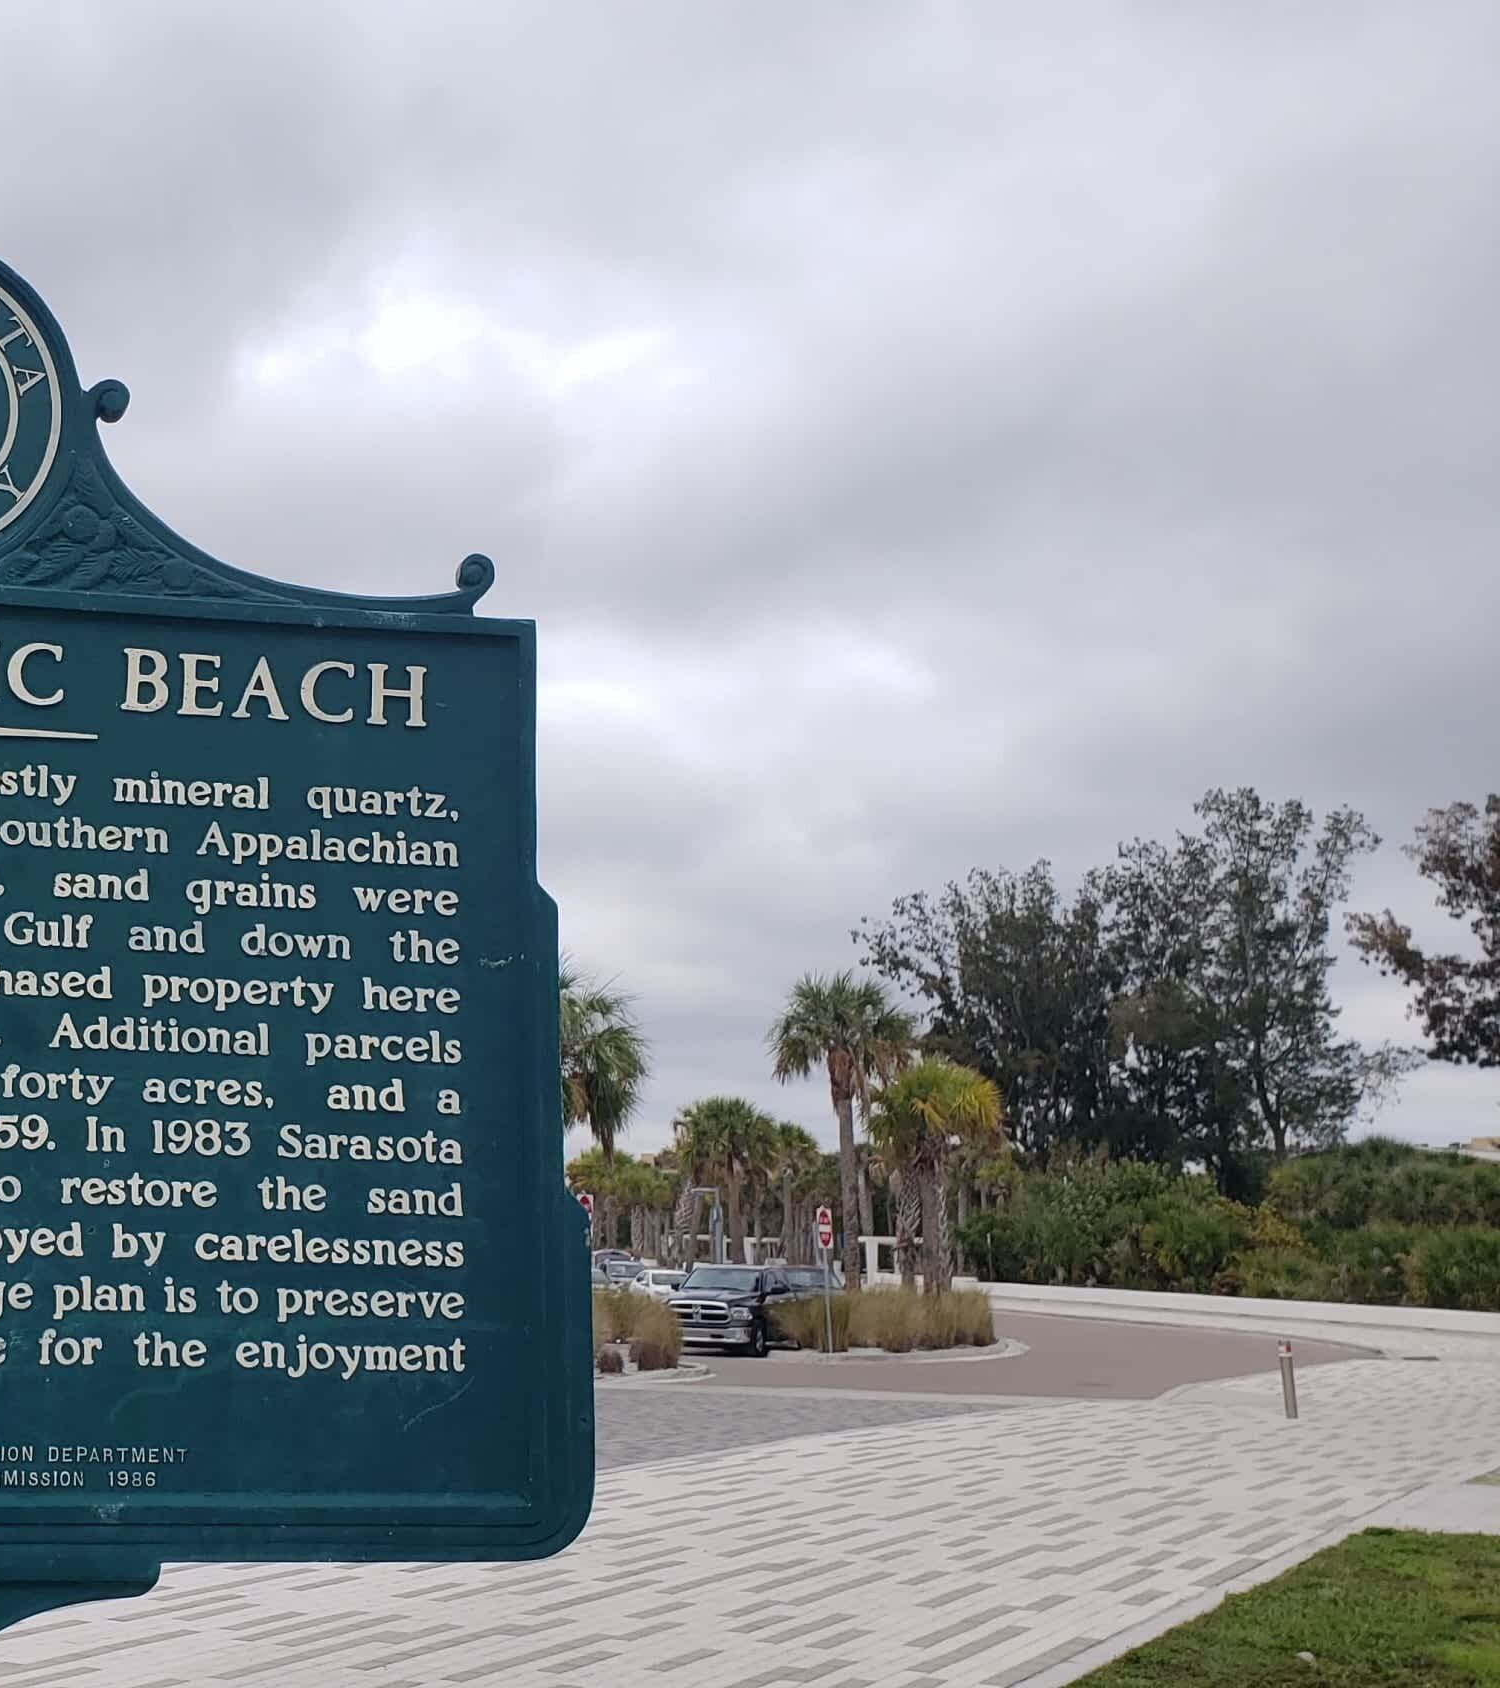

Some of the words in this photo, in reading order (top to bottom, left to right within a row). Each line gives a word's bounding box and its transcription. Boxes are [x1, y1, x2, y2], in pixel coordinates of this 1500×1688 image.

[120, 647, 428, 727] BEACH
[113, 770, 269, 810] mineral
[307, 786, 460, 822] quartz,
[196, 821, 459, 867] Appalachian
[53, 868, 150, 901] sand
[185, 872, 317, 915] grains
[352, 886, 459, 916] were
[3, 911, 94, 949] Gulf
[128, 920, 205, 954] and
[240, 923, 351, 960] down
[388, 929, 460, 965] the
[142, 974, 335, 1014] property
[362, 976, 461, 1014] here
[48, 1012, 270, 1056] Additional
[304, 1030, 462, 1066] parcels
[0, 1063, 115, 1106] forty
[142, 1078, 274, 1109] acres,
[326, 1078, 406, 1112] and
[436, 1089, 462, 1115] a
[85, 1115, 126, 1153] In
[152, 1119, 251, 1156] 1983
[277, 1124, 463, 1165] Sarasota
[60, 1171, 218, 1208] restore
[257, 1175, 327, 1212] the
[367, 1182, 464, 1217] sand
[111, 1223, 167, 1267] by
[194, 1228, 464, 1268] carelessness
[52, 1275, 146, 1320] plan
[163, 1276, 197, 1313] is
[215, 1279, 259, 1314] to
[276, 1287, 465, 1323] preserve
[38, 1328, 103, 1366] for
[133, 1331, 207, 1368] the
[235, 1334, 466, 1380] enjoyment
[48, 1446, 189, 1463] DEPARTMENT
[109, 1470, 156, 1487] 1986
